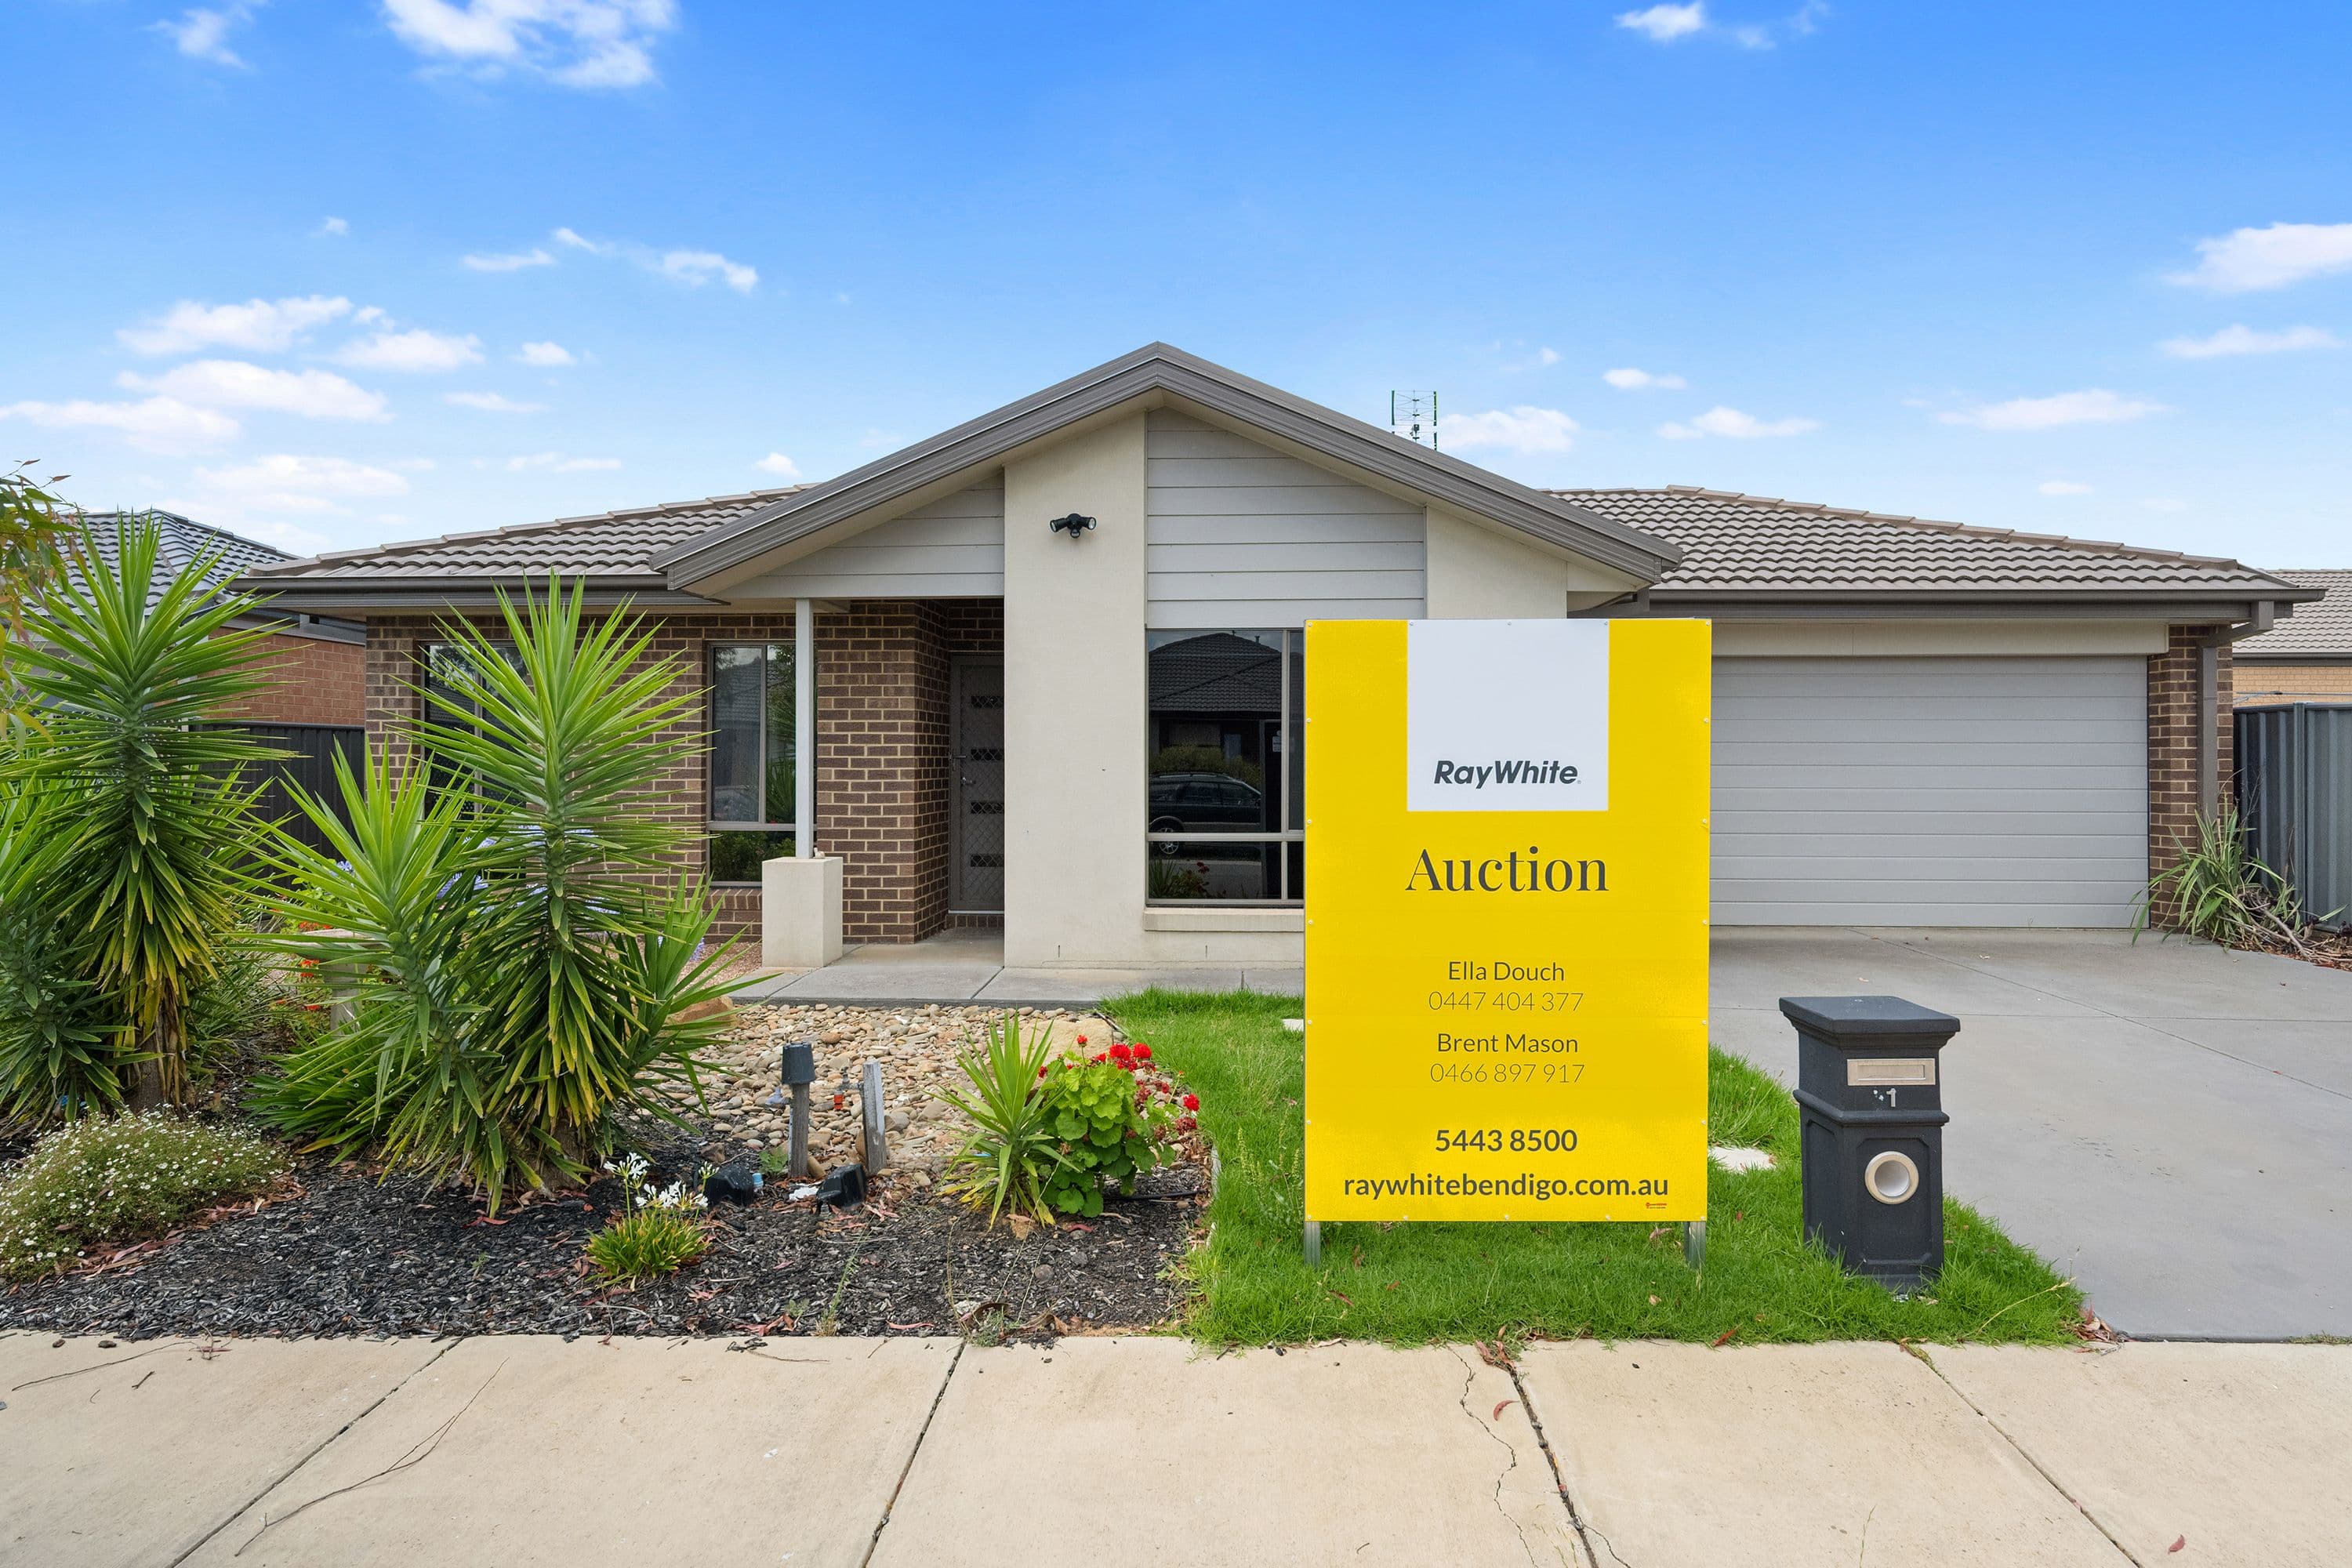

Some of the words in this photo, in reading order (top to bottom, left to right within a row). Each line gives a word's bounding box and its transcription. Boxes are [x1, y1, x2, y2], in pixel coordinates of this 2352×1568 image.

[1405, 846, 1610, 891] Auction
[1448, 961, 1486, 981] Ella
[1494, 961, 1565, 982] Douch
[1428, 991, 1486, 1011] 0447
[1492, 992, 1535, 1011] 404
[1541, 992, 1584, 1011] 377
[1437, 1033, 1499, 1053] Brent
[1505, 1033, 1578, 1053] Mason
[1430, 1063, 1488, 1083] 0466
[1494, 1063, 1537, 1083] 897
[1543, 1064, 1585, 1083] 917
[1886, 1087, 1896, 1107] 1
[1435, 1130, 1503, 1152] 5443
[1510, 1130, 1578, 1152] 8500
[1344, 1173, 1668, 1201] raywhitebendigo.com.au
